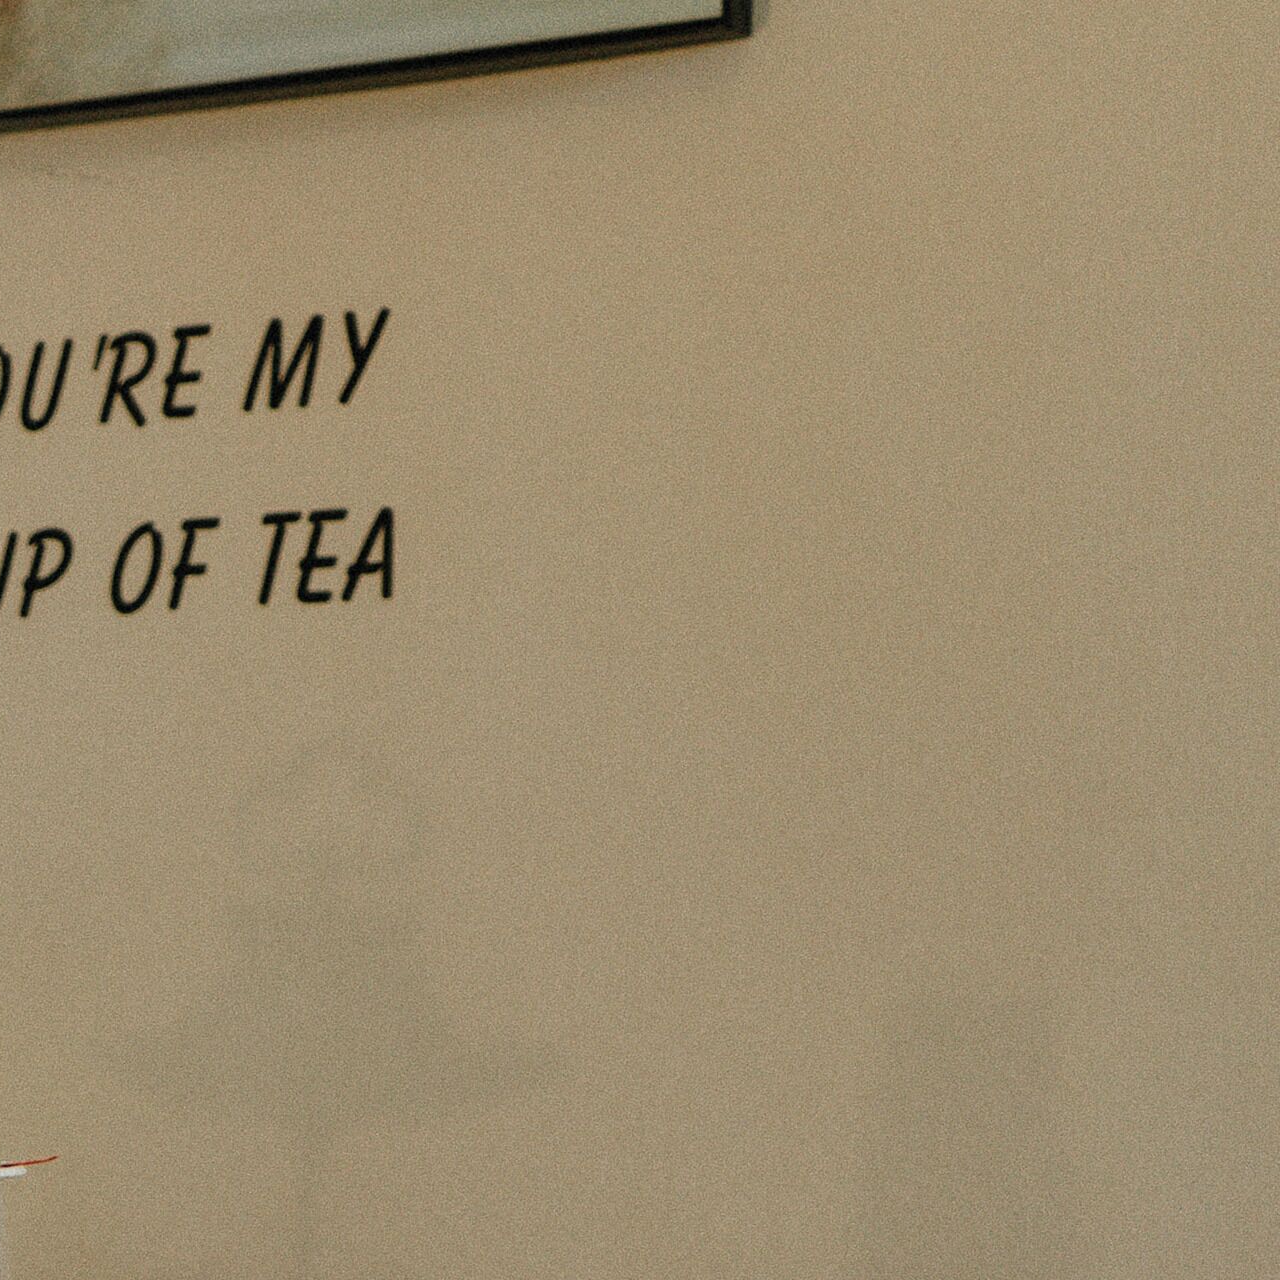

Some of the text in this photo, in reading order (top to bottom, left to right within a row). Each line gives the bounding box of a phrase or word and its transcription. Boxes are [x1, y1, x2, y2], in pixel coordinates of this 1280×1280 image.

[241, 306, 392, 414] MY
[109, 516, 222, 616] OF
[257, 505, 396, 607] TEA
